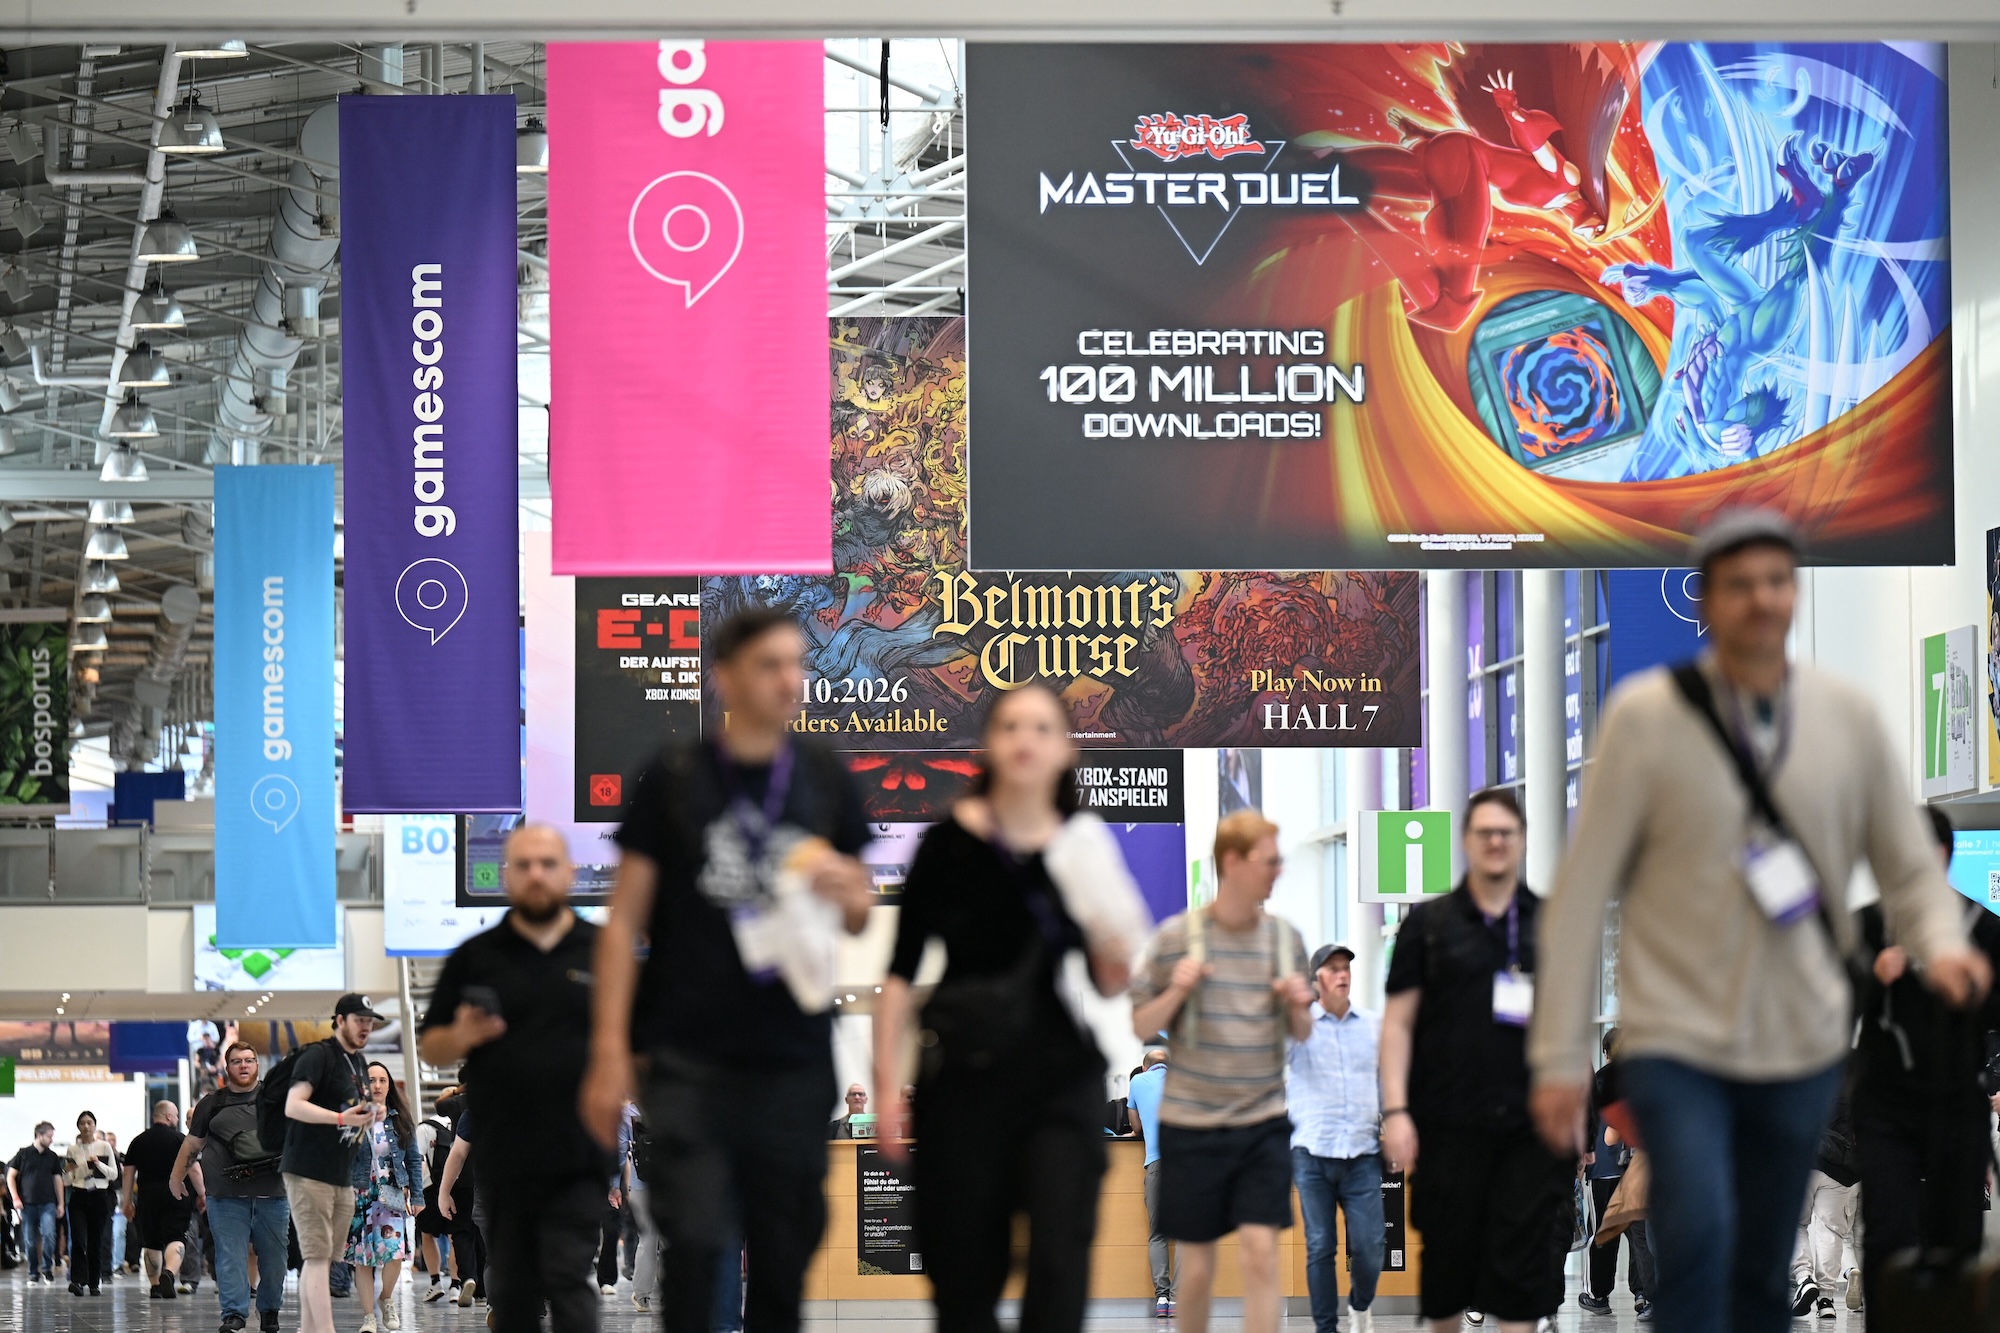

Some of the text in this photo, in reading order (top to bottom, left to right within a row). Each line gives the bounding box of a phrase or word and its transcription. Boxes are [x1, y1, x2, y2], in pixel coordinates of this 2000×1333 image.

[1149, 126, 1246, 145] Yu-Gi-Oh!
[1040, 163, 1360, 215] MASTER DUEL
[1078, 330, 1325, 356] CELEBRATING
[1039, 365, 1364, 403] 100 MILLION
[412, 263, 456, 537] gamescom
[1083, 412, 1322, 439] DOWNLOADS!
[932, 569, 1175, 640] Belmont's
[263, 576, 292, 762] gamescom
[619, 656, 700, 669] DER AUFST
[980, 631, 1140, 691] Curse
[645, 688, 669, 701] XBOX
[1250, 668, 1382, 700] Play Now in
[28, 648, 58, 776] bosporus
[844, 709, 949, 734] Available
[1263, 703, 1379, 731] HALL 7
[1932, 671, 1945, 778] 7
[1075, 767, 1168, 786] XBOX-STAND
[600, 786, 612, 797] 18
[1076, 788, 1168, 807] 7 ANSPIELEN
[402, 826, 456, 855] BO
[480, 871, 491, 882] 12
